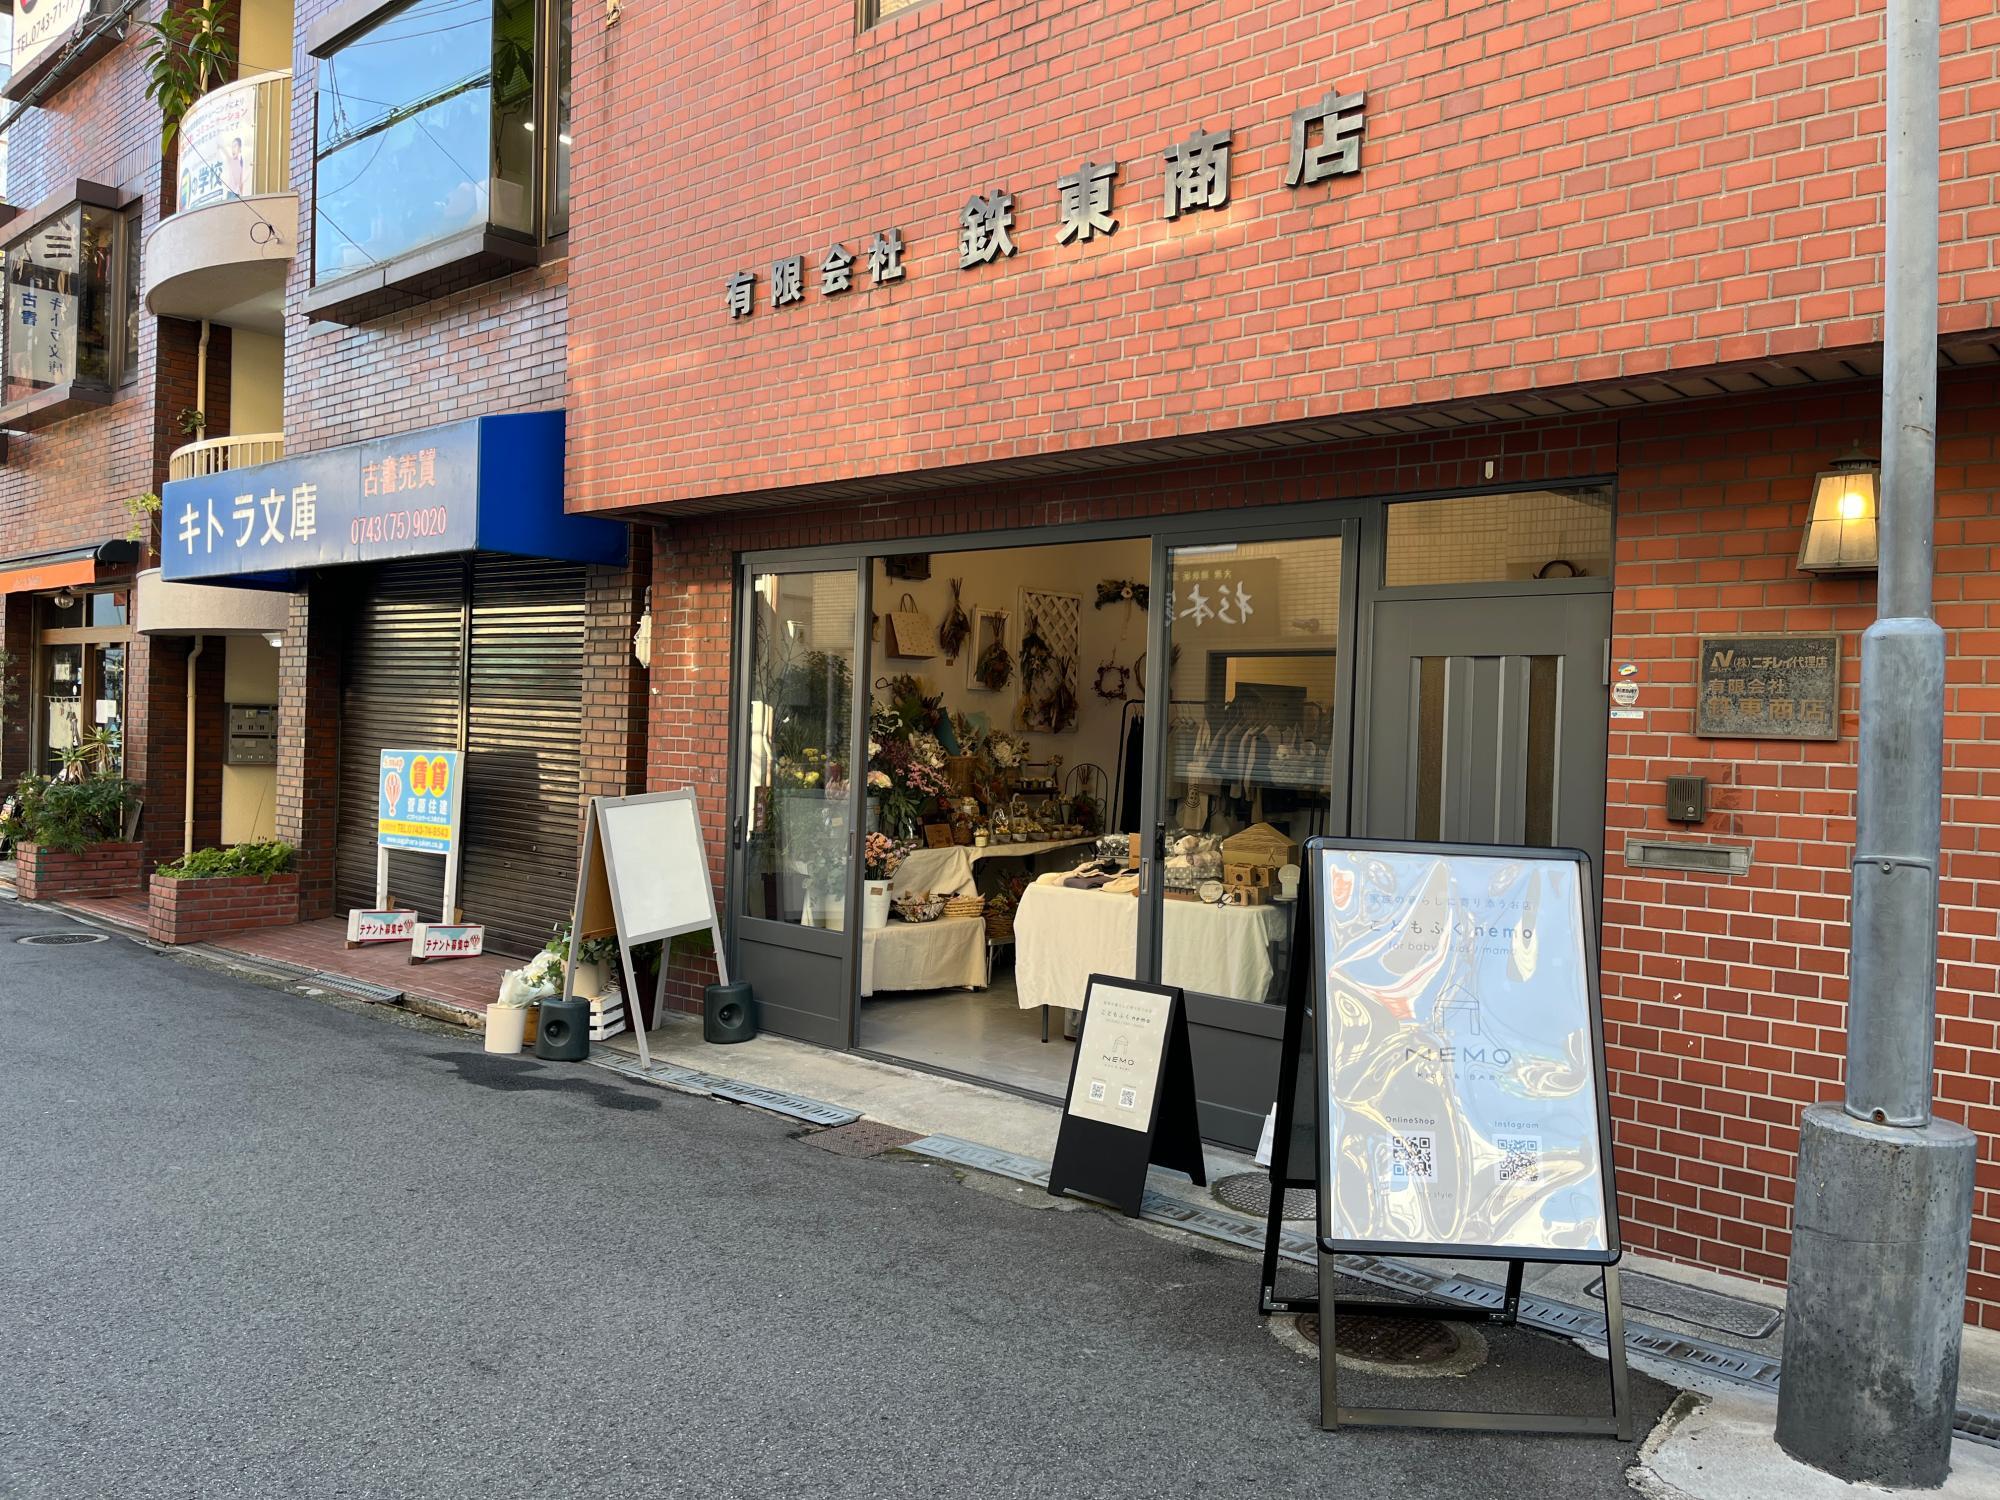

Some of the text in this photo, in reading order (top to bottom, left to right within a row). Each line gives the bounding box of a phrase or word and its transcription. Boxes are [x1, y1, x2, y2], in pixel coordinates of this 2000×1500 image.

[725, 229, 906, 318] 有限会社
[362, 448, 436, 497] 古書売買
[178, 482, 317, 555] キトラ文庫
[350, 506, 447, 545] 0743(75)9020
[1709, 679, 1791, 694] 有限会社
[413, 760, 447, 793] 賃貸
[360, 923, 404, 936] テナント募集中
[426, 939, 470, 952] テナント募集中
[1102, 1054, 1136, 1067] NEMO
[1405, 1048, 1512, 1065] NEMO
[1385, 1115, 1436, 1126] OnlineShop
[1494, 1119, 1540, 1131] Instagram
